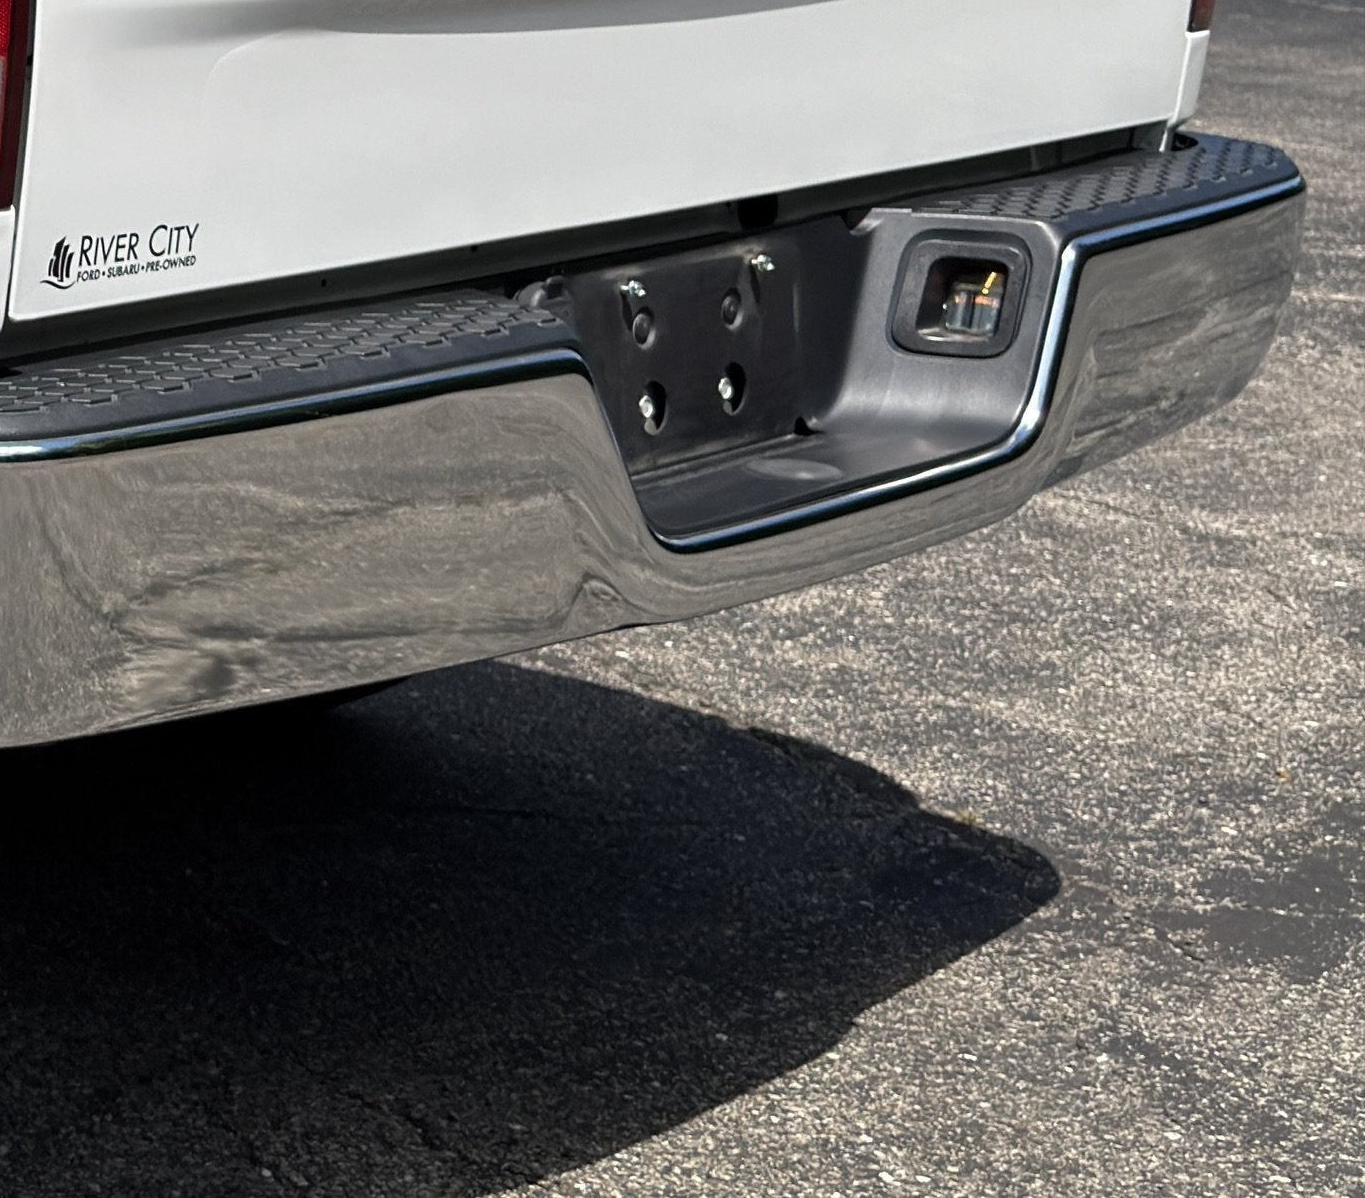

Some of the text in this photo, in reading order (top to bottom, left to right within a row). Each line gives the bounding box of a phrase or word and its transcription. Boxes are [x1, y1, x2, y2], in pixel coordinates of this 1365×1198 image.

[78, 223, 200, 267] RIVER CITY
[76, 255, 197, 282] FORD SUBARU PRE-OWNED
